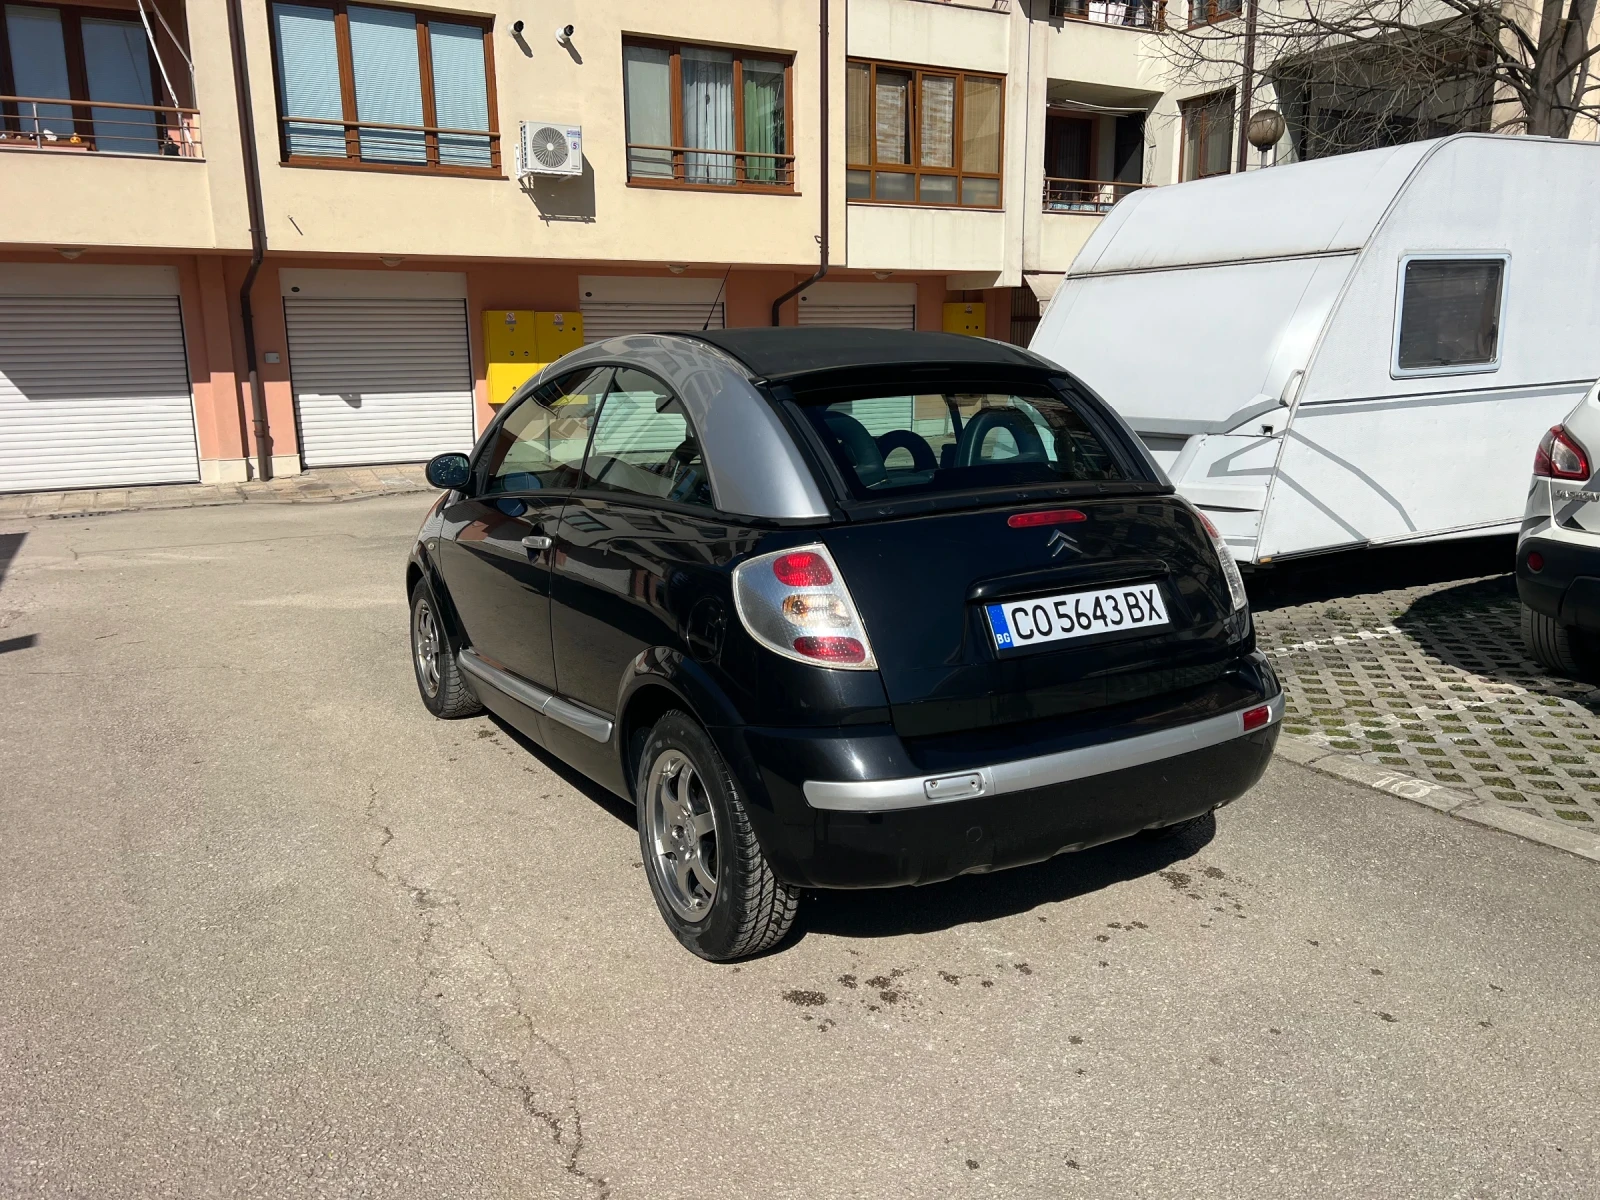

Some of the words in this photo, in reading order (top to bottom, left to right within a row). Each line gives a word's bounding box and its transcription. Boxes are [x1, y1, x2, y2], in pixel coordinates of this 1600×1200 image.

[1053, 594, 1124, 633] 5643
[1123, 589, 1163, 624] BX
[997, 633, 1011, 644] BG
